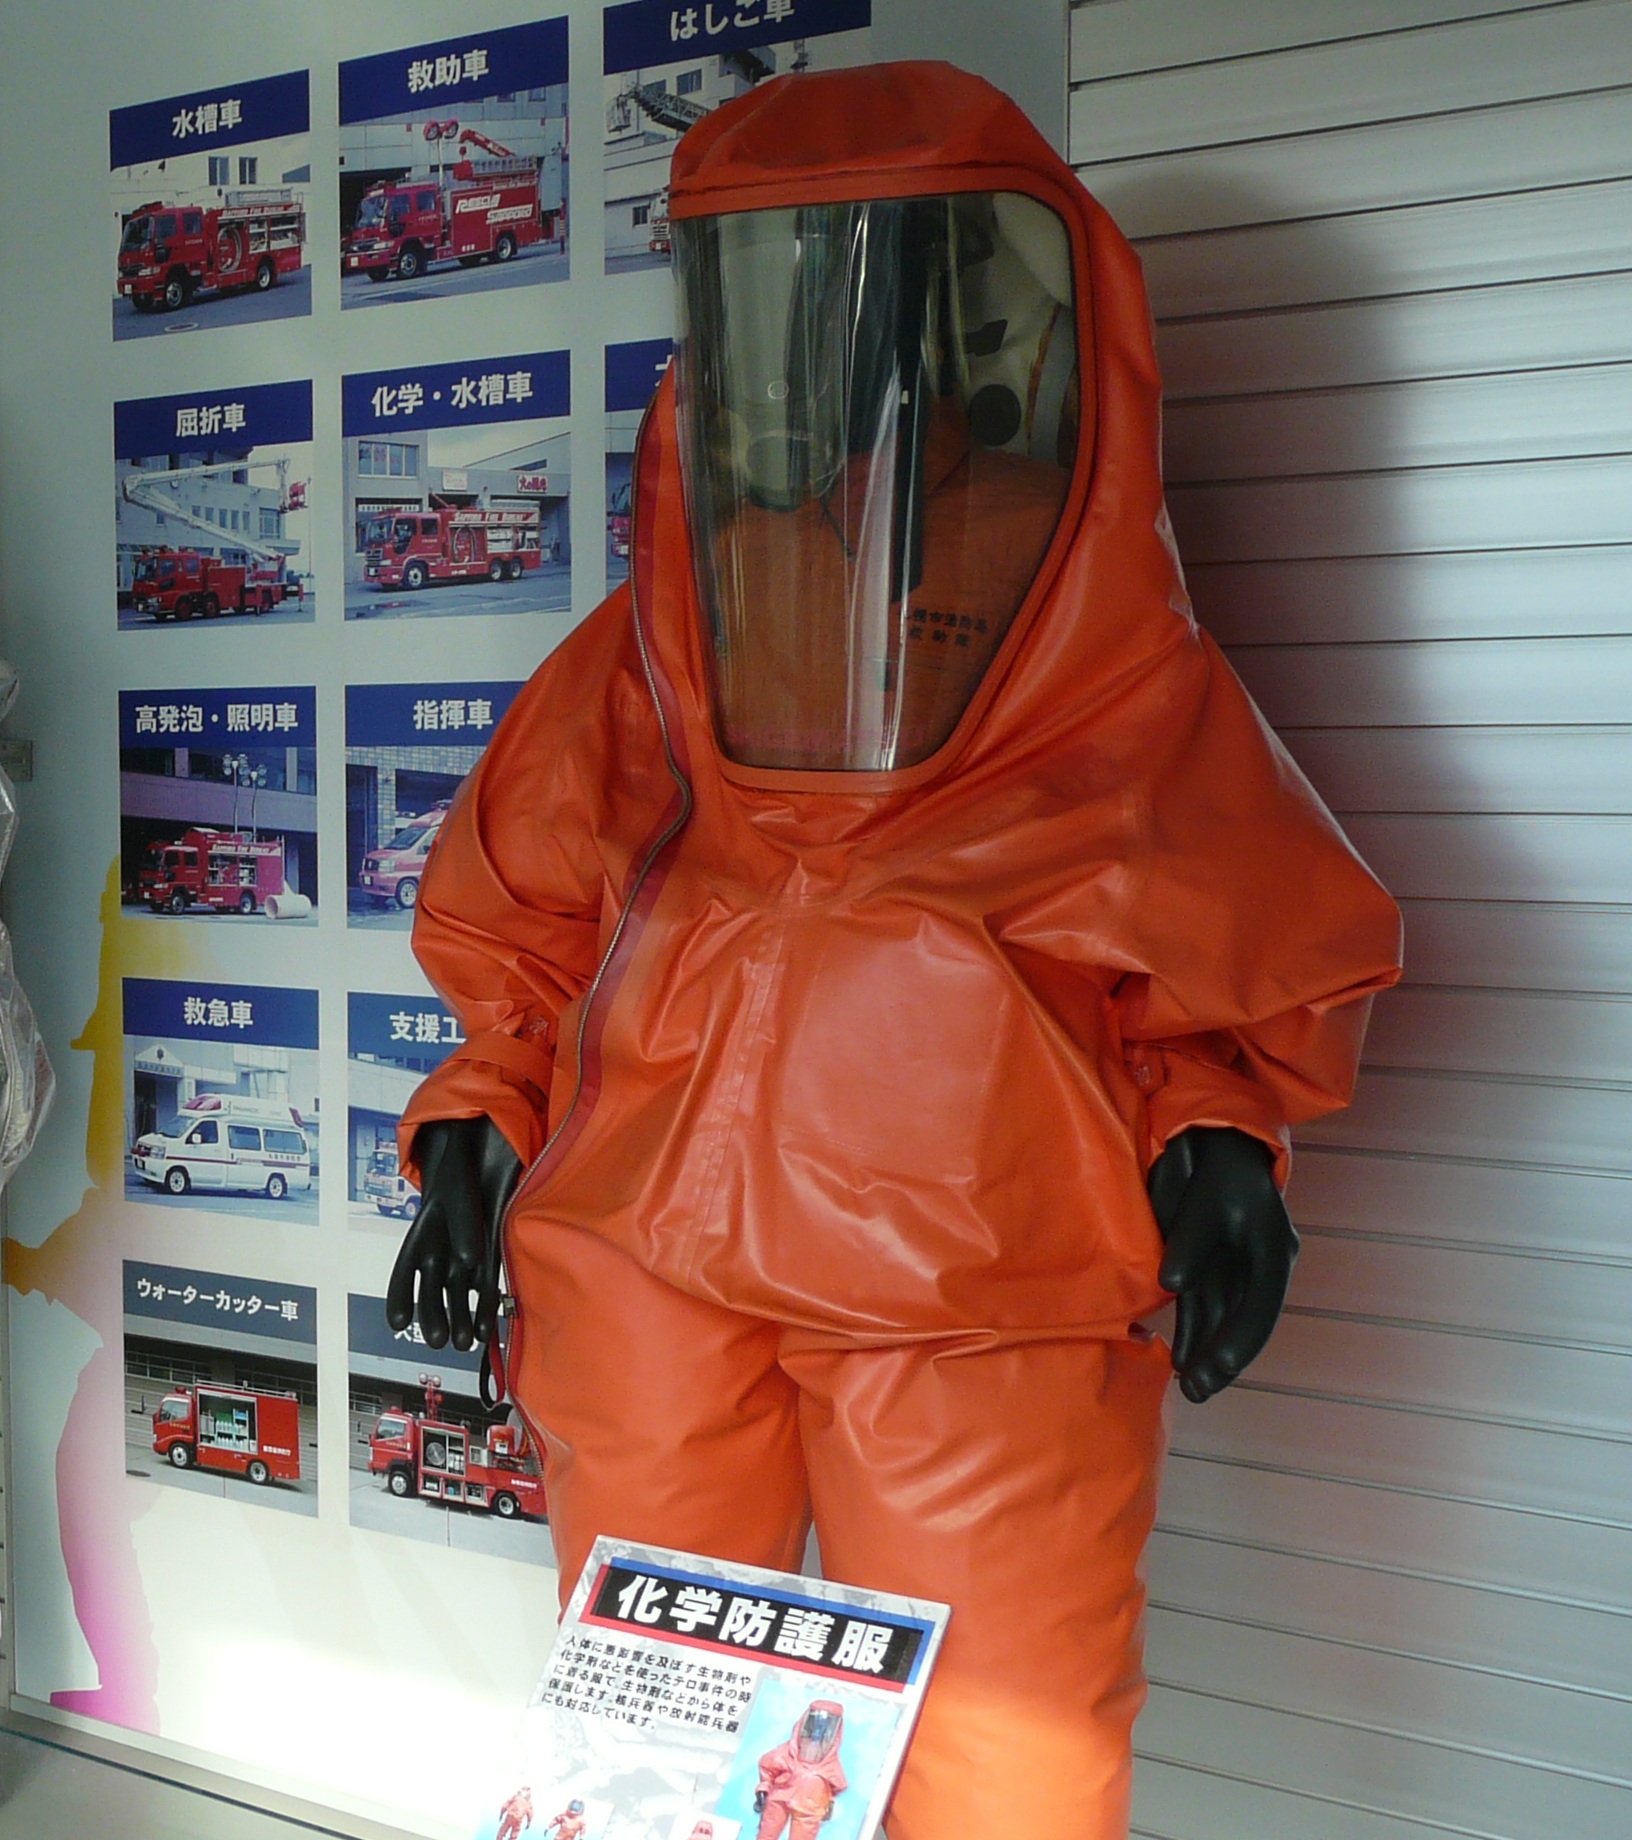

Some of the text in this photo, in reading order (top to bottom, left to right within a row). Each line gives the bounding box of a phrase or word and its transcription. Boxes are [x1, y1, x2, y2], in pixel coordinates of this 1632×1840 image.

[407, 48, 489, 94] 救助車
[171, 99, 243, 139] 水槽車
[371, 371, 534, 417] 化学・水槽車
[175, 403, 246, 438] 屈折車
[135, 702, 299, 733] 高発泡・照明車
[413, 699, 493, 731] 指揮車
[183, 996, 253, 1029] 救急車
[136, 1278, 299, 1322] ウォーターカッター車
[617, 1574, 896, 1675] 化学防護服
[560, 1649, 753, 1704] 化学剤などを使ったテロ事件の時
